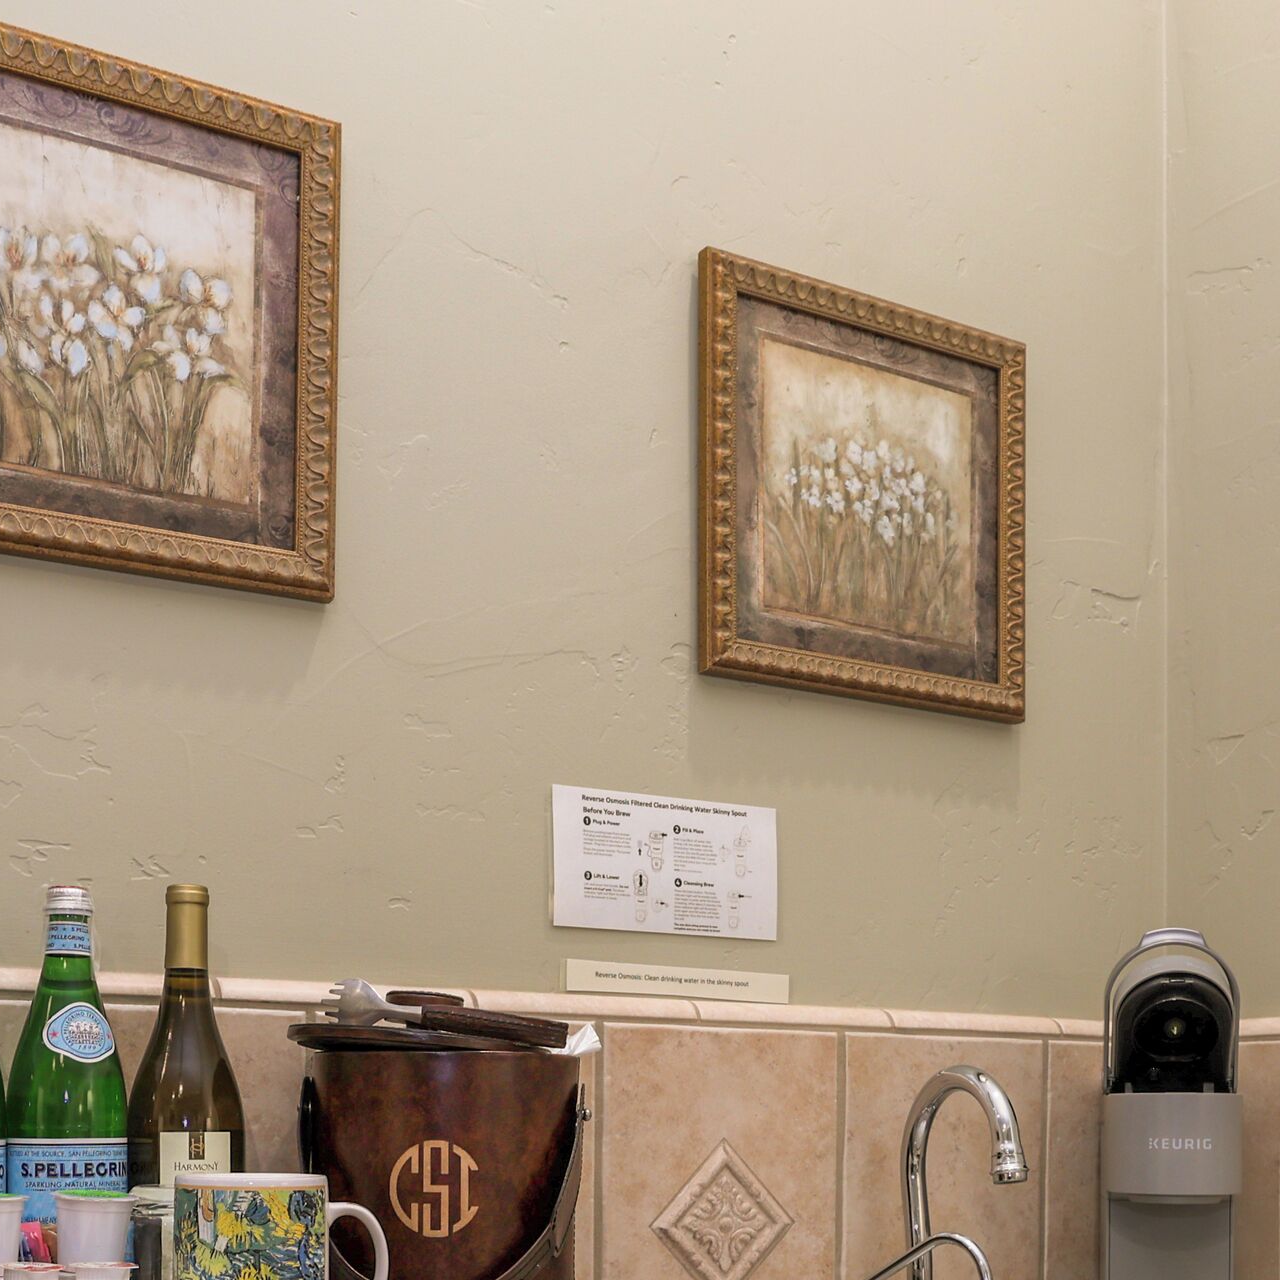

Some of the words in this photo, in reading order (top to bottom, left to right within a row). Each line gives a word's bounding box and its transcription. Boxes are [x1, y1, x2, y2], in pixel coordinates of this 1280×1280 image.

[582, 794, 604, 802] Reverse
[606, 797, 630, 805] Osmosis
[630, 800, 652, 808] Filtered
[670, 804, 694, 812] Drinking
[712, 808, 730, 816] Skinny
[582, 806, 602, 814] Before
[660, 975, 682, 984] drinking
[1148, 1138, 1212, 1150] KEURIG
[21, 1162, 127, 1178] S.PELLEGRIN
[174, 1161, 219, 1172] HARMONY
